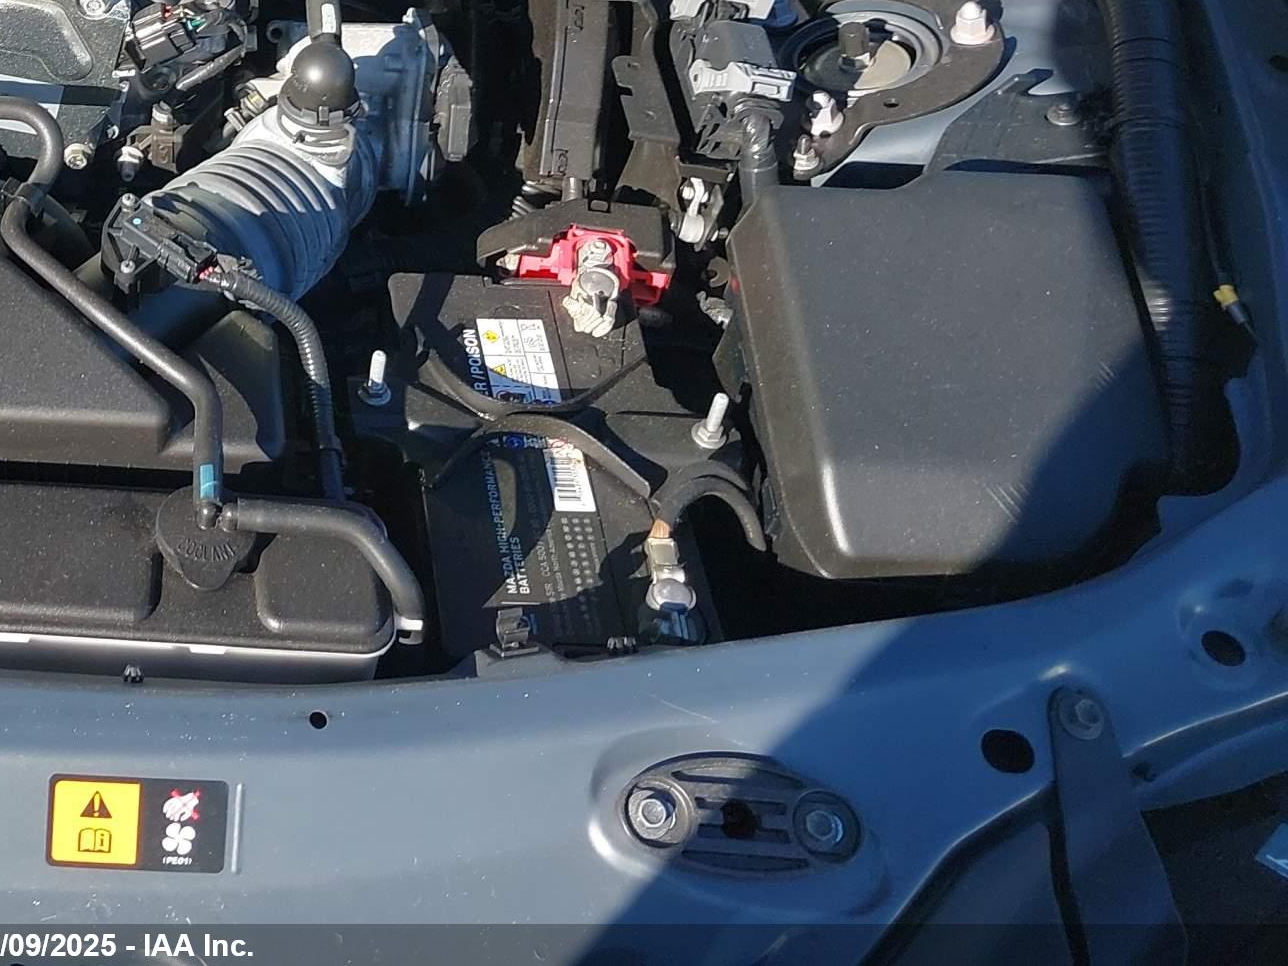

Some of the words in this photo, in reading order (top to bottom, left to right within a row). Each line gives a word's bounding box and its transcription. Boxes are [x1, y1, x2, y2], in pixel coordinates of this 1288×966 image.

[462, 329, 485, 374] POISON
[480, 449, 510, 554] HIGH-PERFORMANCE
[176, 538, 235, 562] COOLANT
[509, 536, 530, 595] BATTERIES
[502, 555, 518, 594] MAZDA
[162, 856, 193, 866] (PE01)
